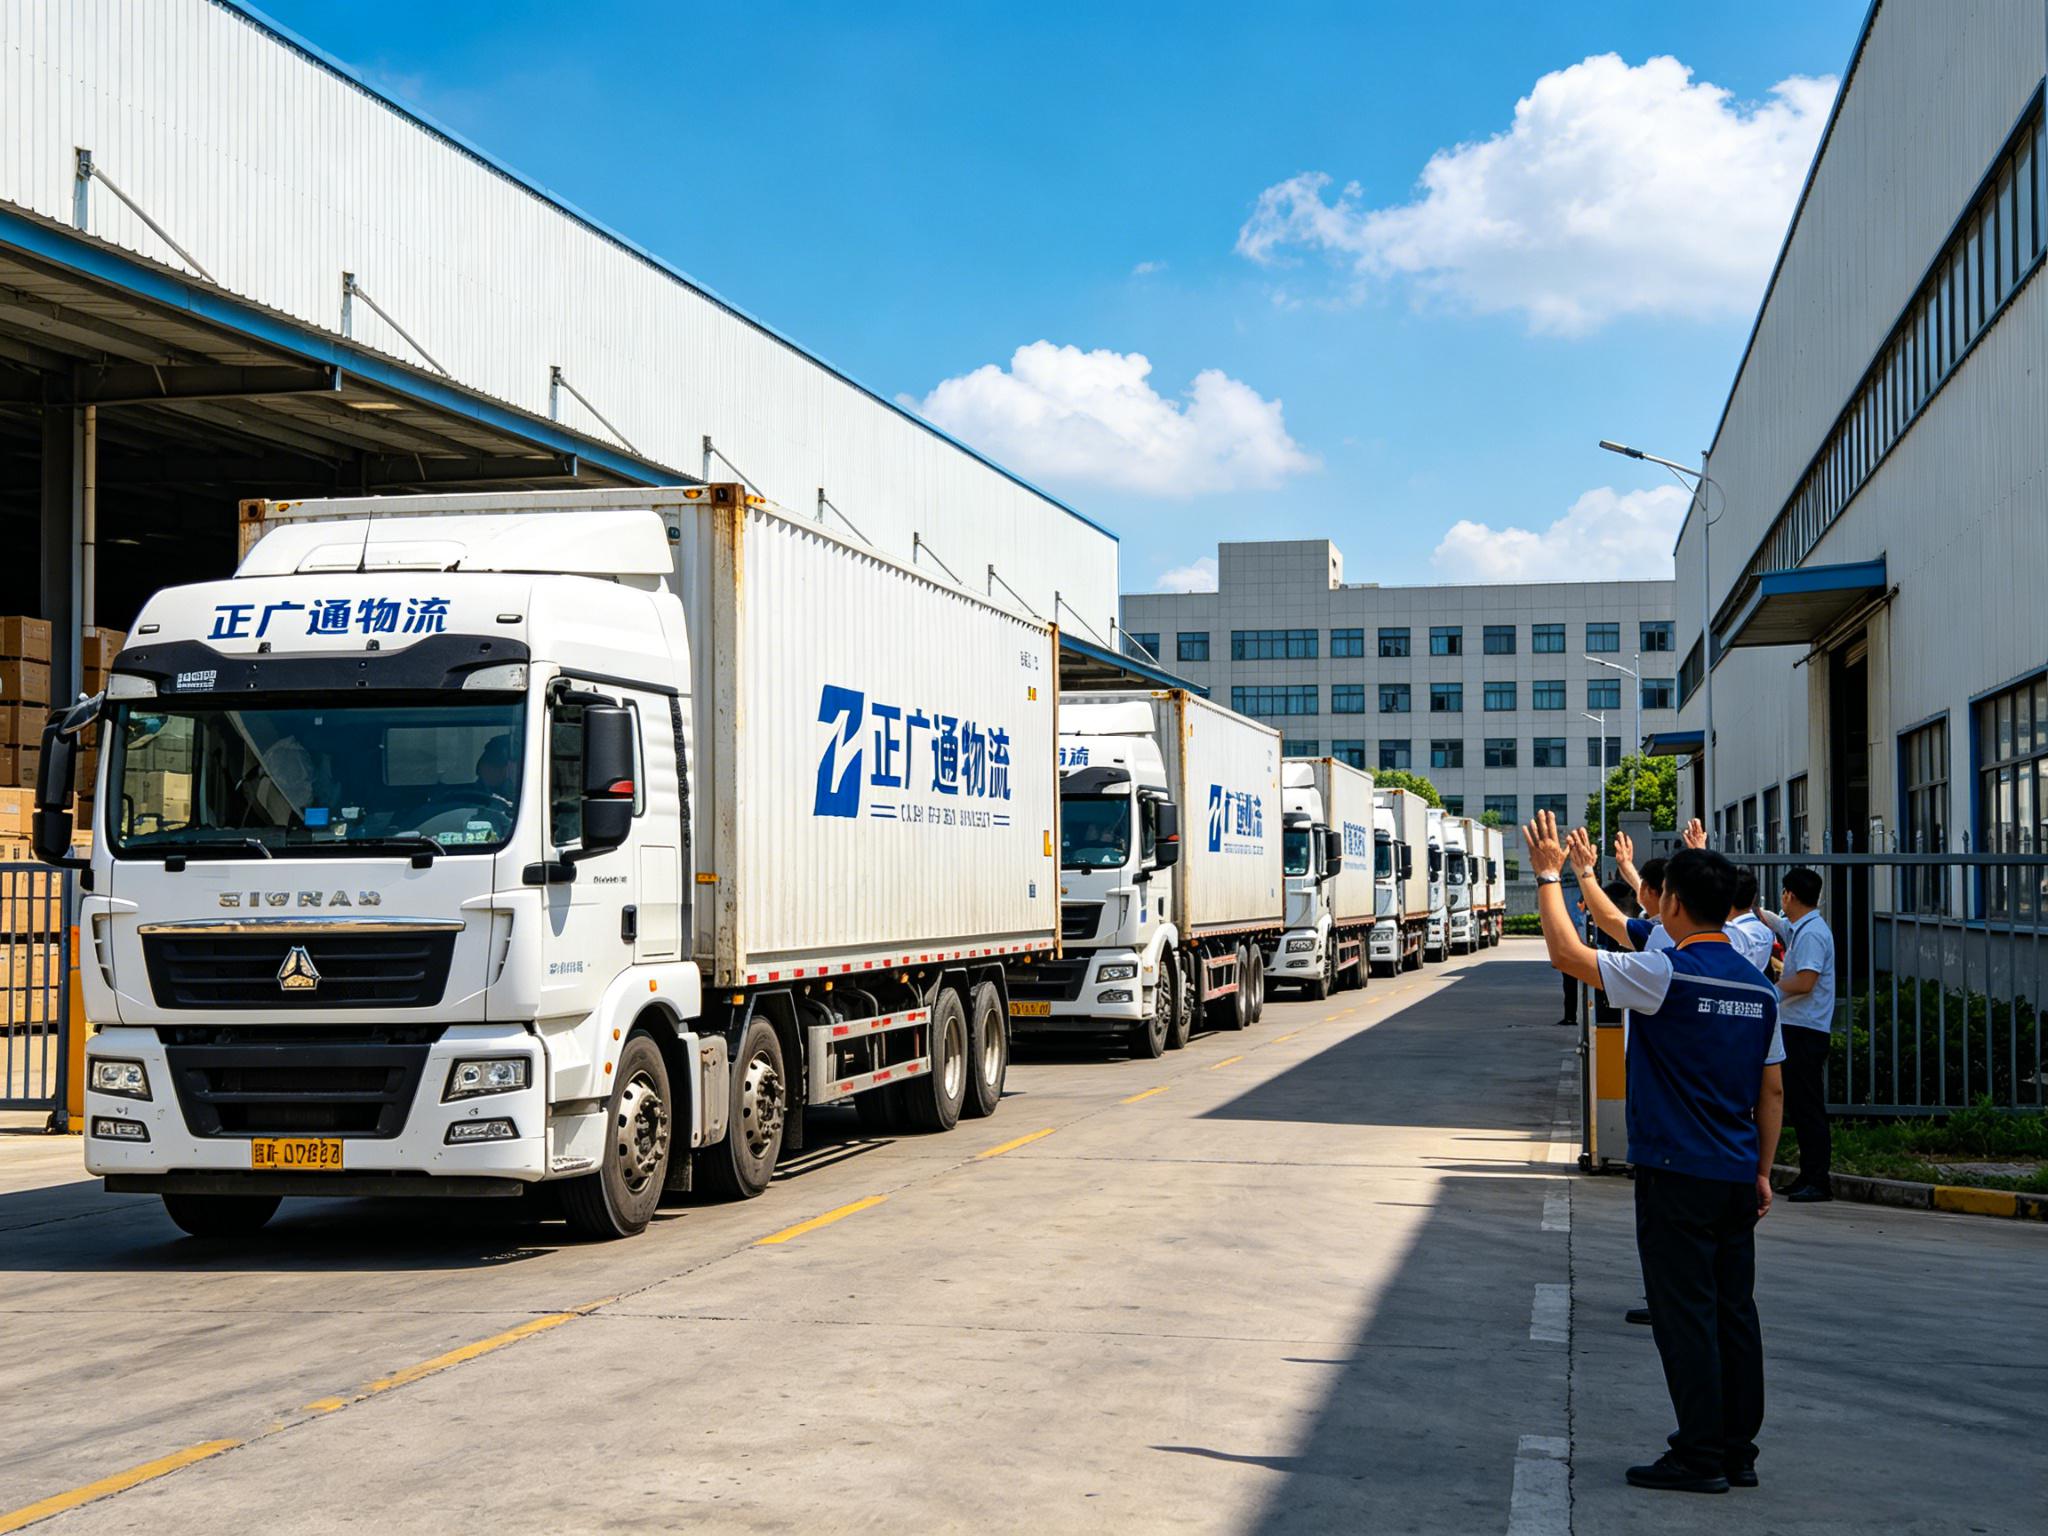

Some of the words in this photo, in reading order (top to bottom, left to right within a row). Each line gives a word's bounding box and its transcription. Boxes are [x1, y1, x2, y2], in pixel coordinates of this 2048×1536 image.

[207, 597, 451, 640] 正广通物流
[870, 702, 1011, 800] 正广通物流
